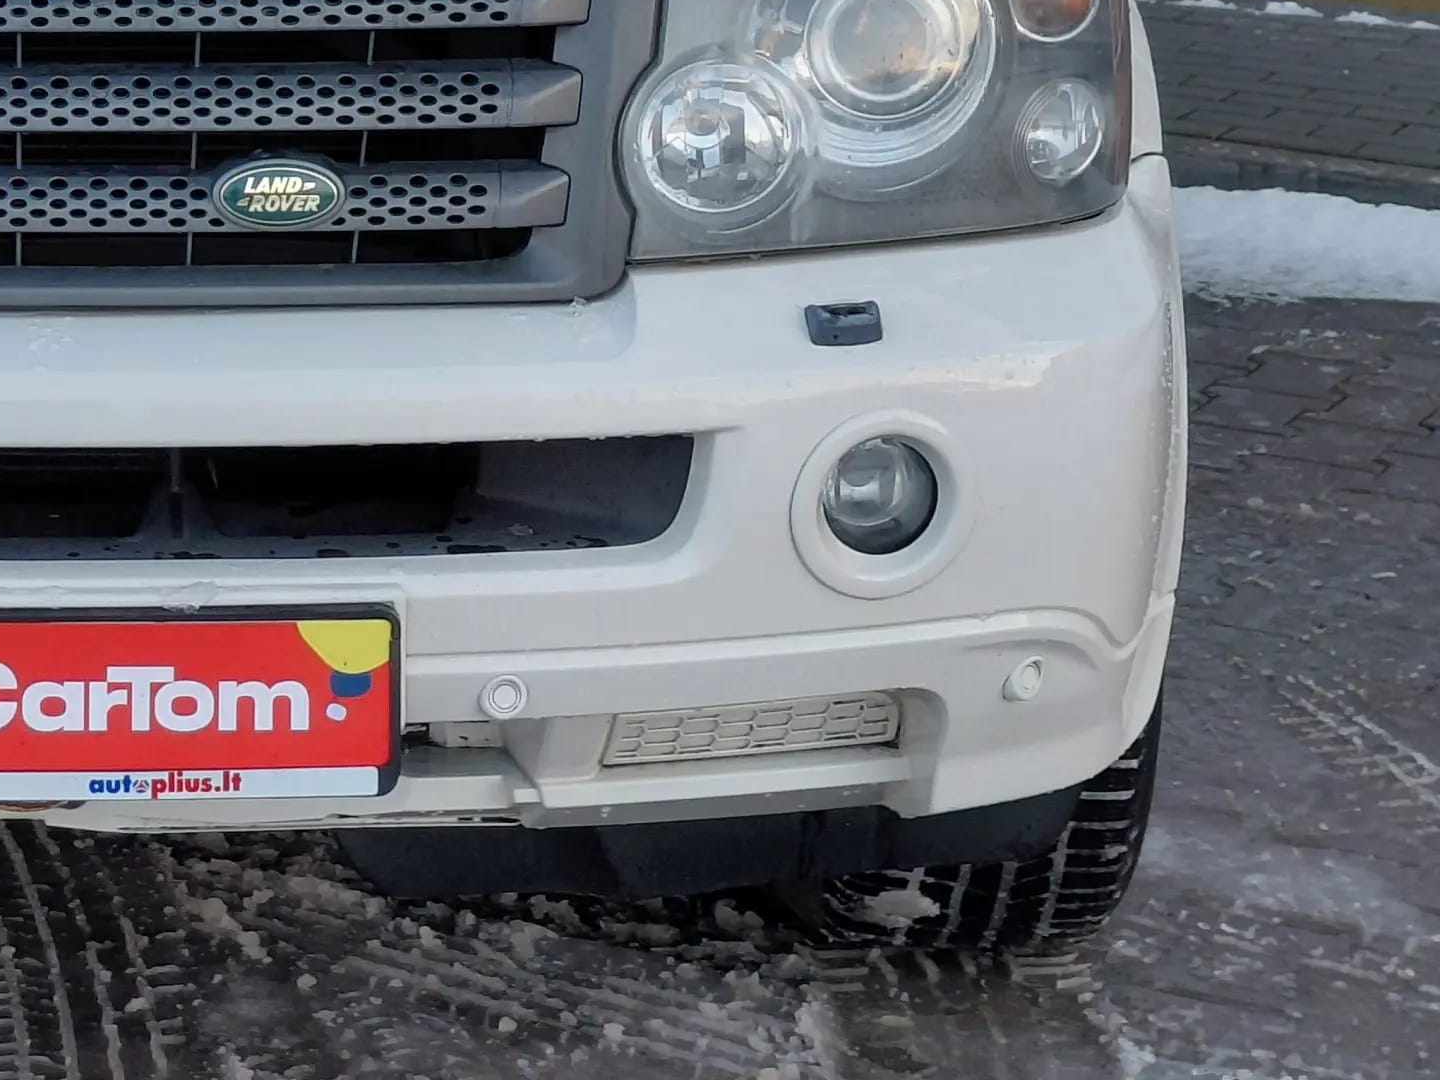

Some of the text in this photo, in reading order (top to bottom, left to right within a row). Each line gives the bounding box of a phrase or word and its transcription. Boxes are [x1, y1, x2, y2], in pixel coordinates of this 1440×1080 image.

[244, 176, 303, 194] LAND
[248, 194, 320, 213] ROVER
[88, 771, 242, 800] autoplius.lt
